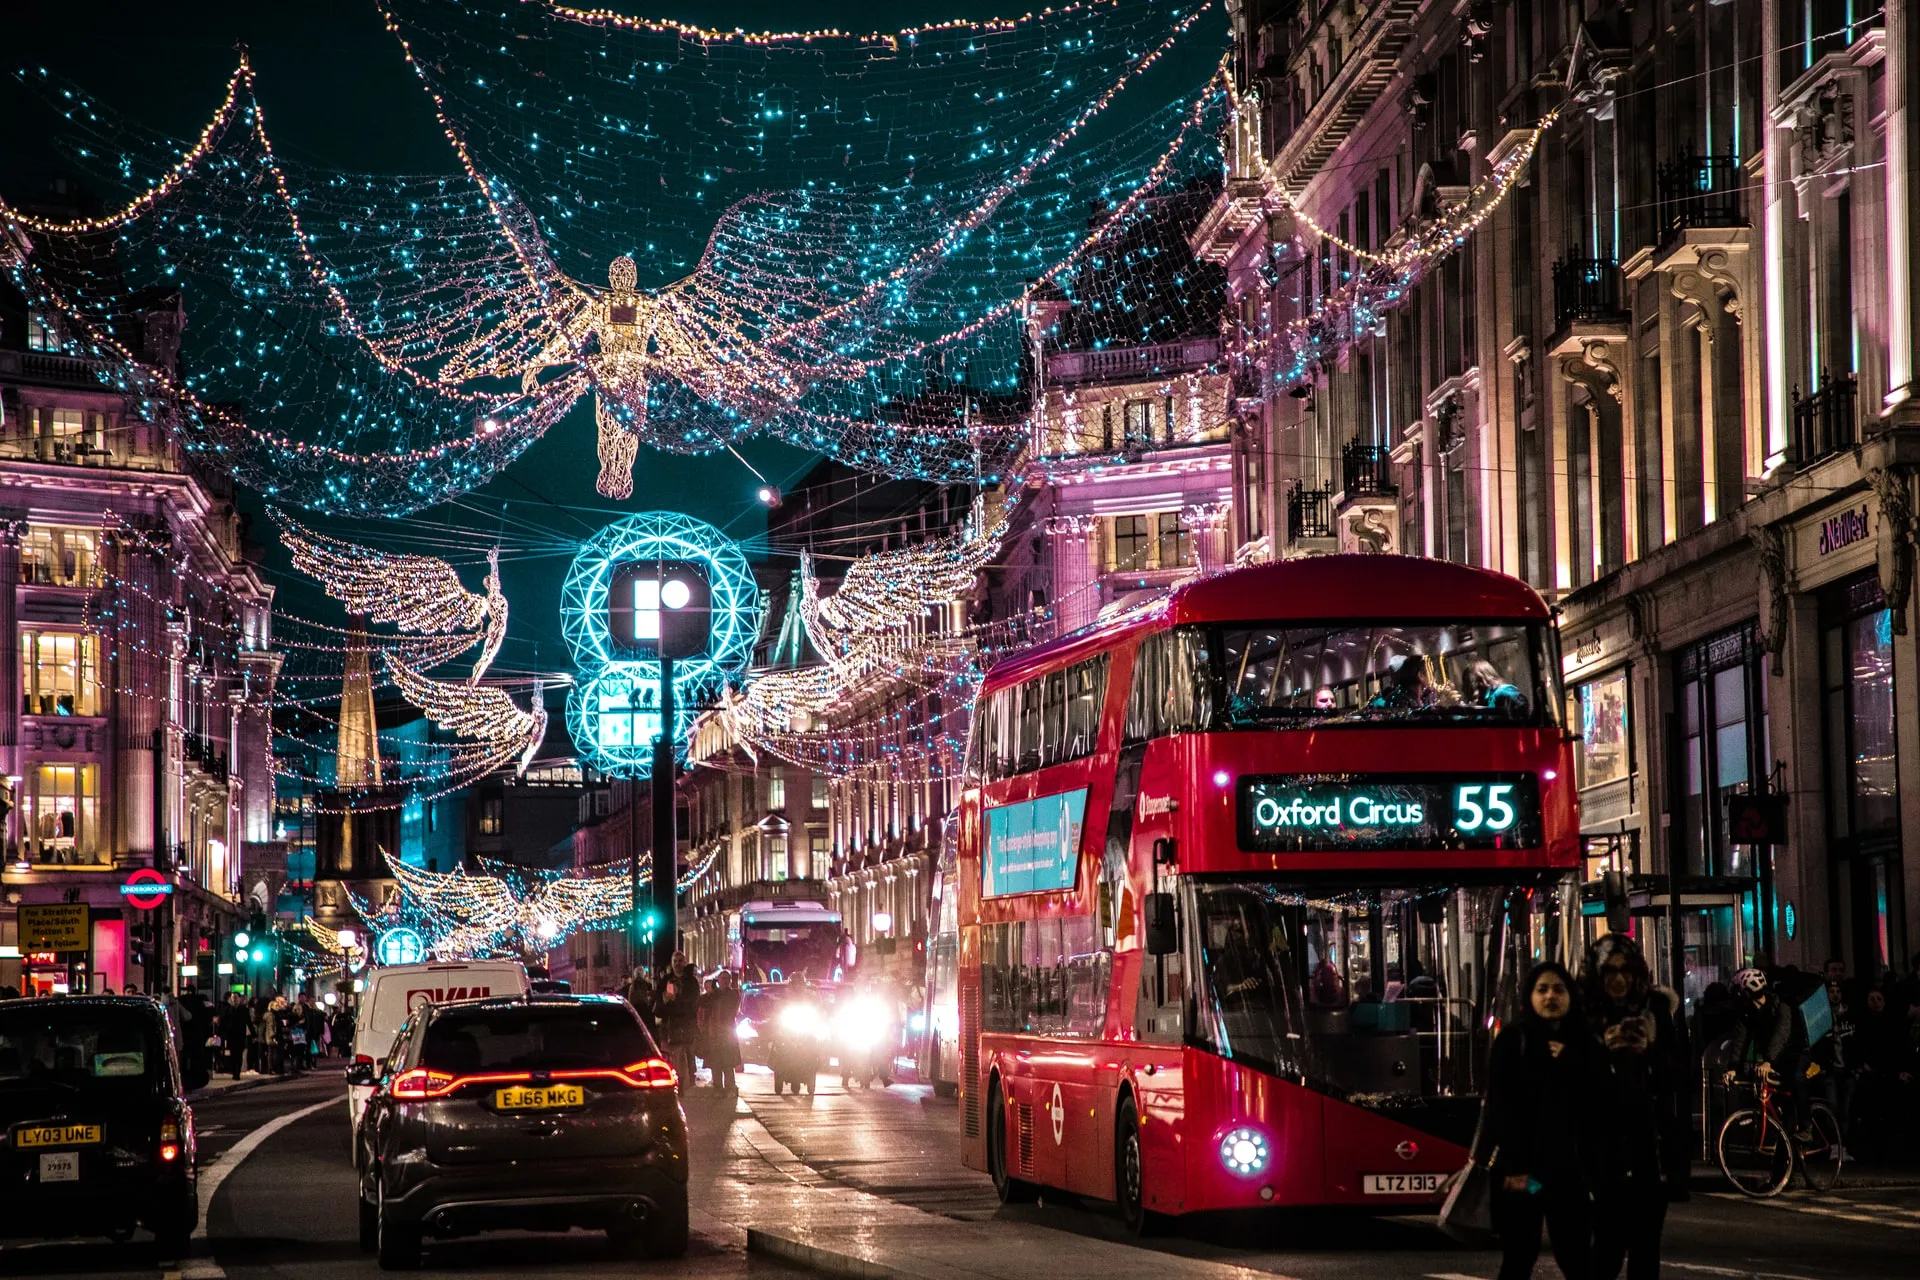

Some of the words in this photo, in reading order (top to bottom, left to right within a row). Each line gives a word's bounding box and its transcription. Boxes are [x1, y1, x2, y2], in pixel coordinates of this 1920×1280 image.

[1827, 504, 1869, 552] NatWest
[1256, 797, 1340, 826] Oxford
[1349, 797, 1423, 824] Circus
[1456, 785, 1514, 830] 55
[42, 907, 82, 916] Stratford
[27, 918, 80, 927] Place/South
[32, 927, 62, 936] Molton
[504, 1092, 543, 1106] EJ66
[23, 1129, 61, 1143] LY03
[65, 1127, 94, 1141] UNE
[1375, 1176, 1405, 1191] LTZ
[1409, 1176, 1437, 1191] 1313
